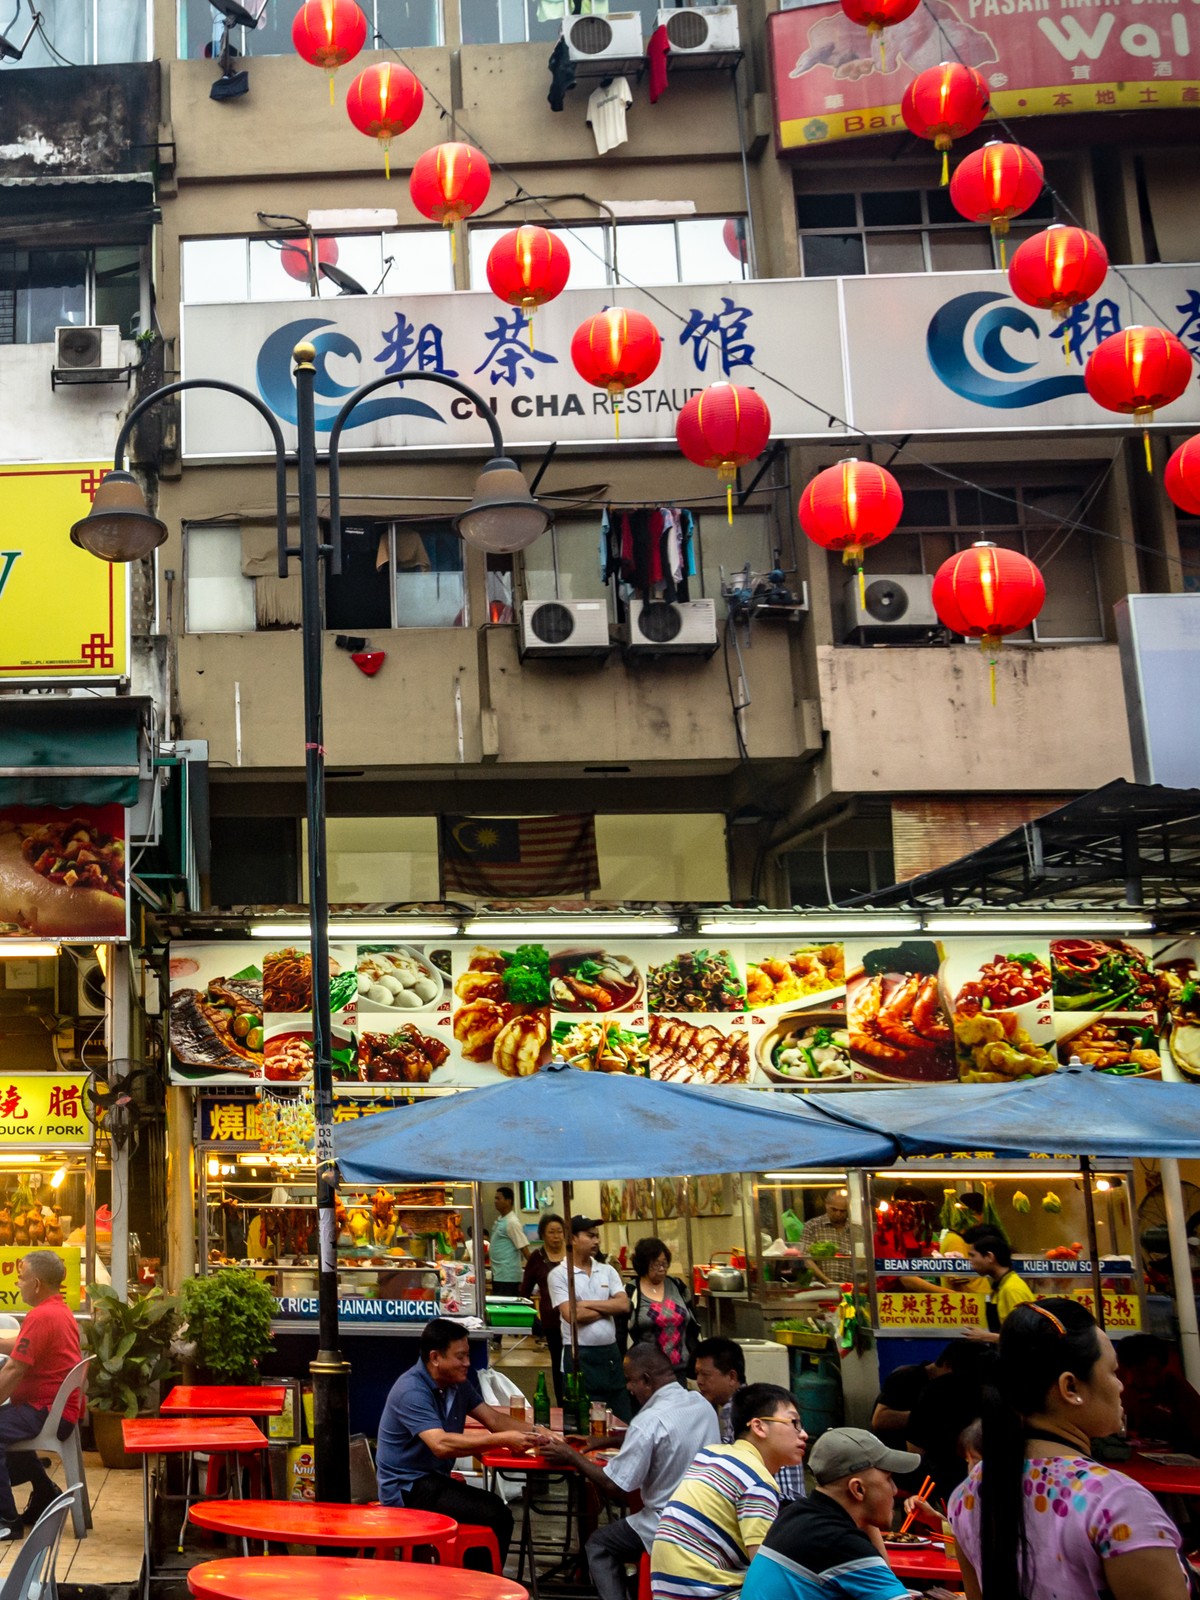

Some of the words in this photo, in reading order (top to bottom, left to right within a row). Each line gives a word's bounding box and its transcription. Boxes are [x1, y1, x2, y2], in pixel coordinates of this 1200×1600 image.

[511, 394, 585, 417] CHA
[592, 386, 756, 415] RESTAU
[46, 1125, 84, 1136] PORK
[318, 1128, 332, 1137] D3
[884, 1260, 909, 1270] BEAN
[911, 1260, 953, 1271] SPROUTS
[1023, 1260, 1048, 1271] KUEH
[1050, 1261, 1077, 1271] TEOW
[1078, 1262, 1105, 1272] SOP
[288, 1298, 318, 1313] RICE
[338, 1299, 382, 1315] HAINAN
[386, 1300, 442, 1316] CHICKEN
[880, 1316, 906, 1324] SPICY
[910, 1316, 935, 1324] WAN
[937, 1316, 957, 1324] TAN
[961, 1316, 980, 1325] MEE
[1104, 1317, 1136, 1327] OODLE
